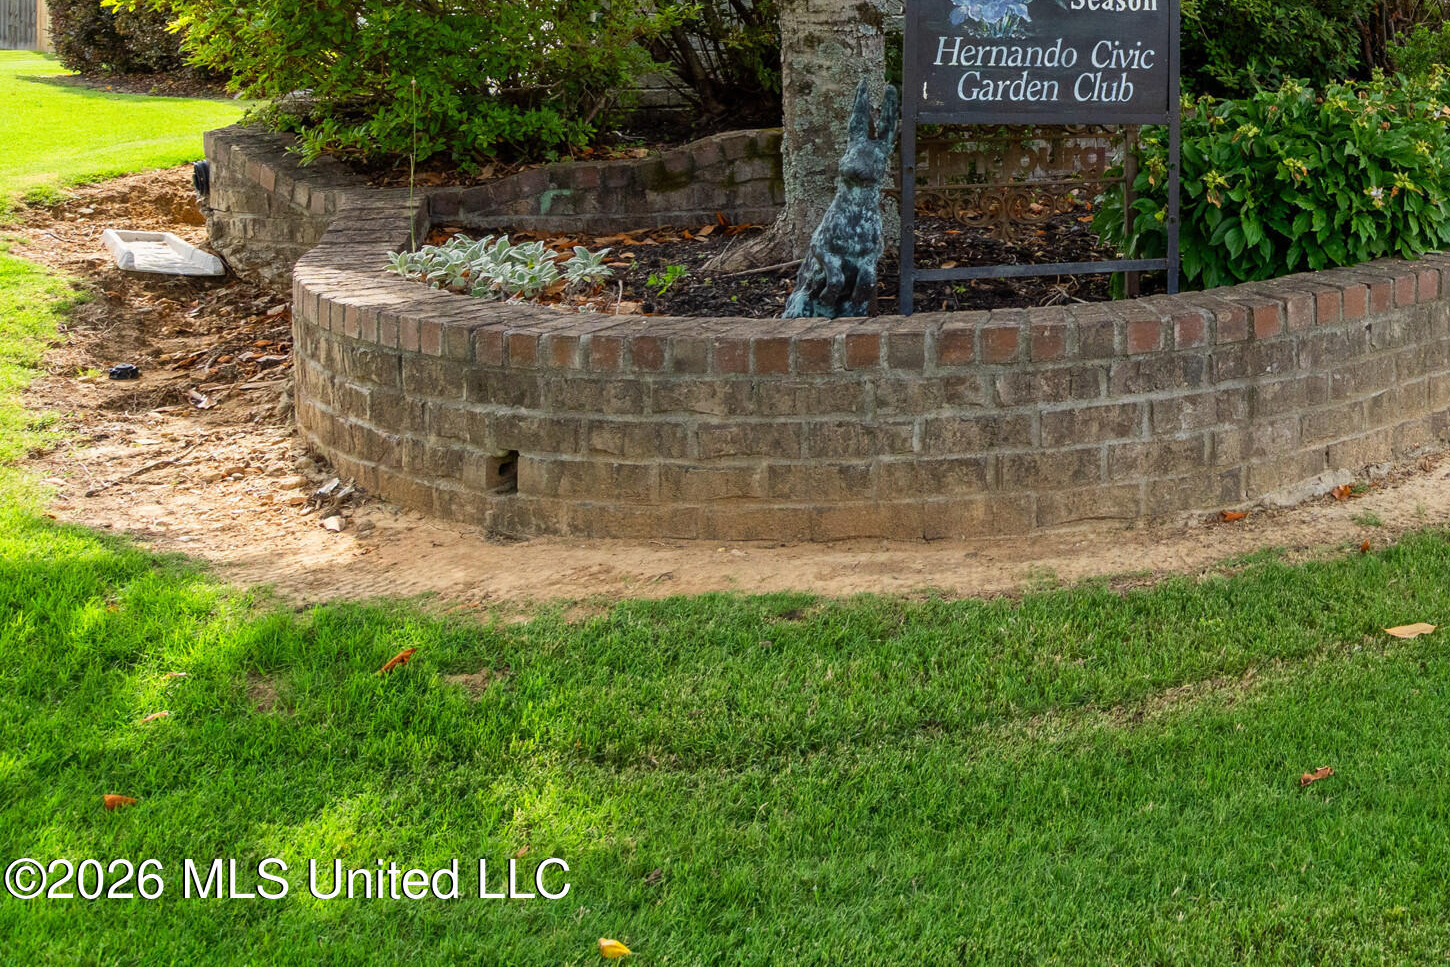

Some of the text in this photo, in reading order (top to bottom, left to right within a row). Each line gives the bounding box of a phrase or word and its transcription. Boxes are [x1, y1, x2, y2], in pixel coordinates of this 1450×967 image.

[933, 36, 1155, 69] Hernando Civic
[957, 71, 1134, 102] Garden Club
